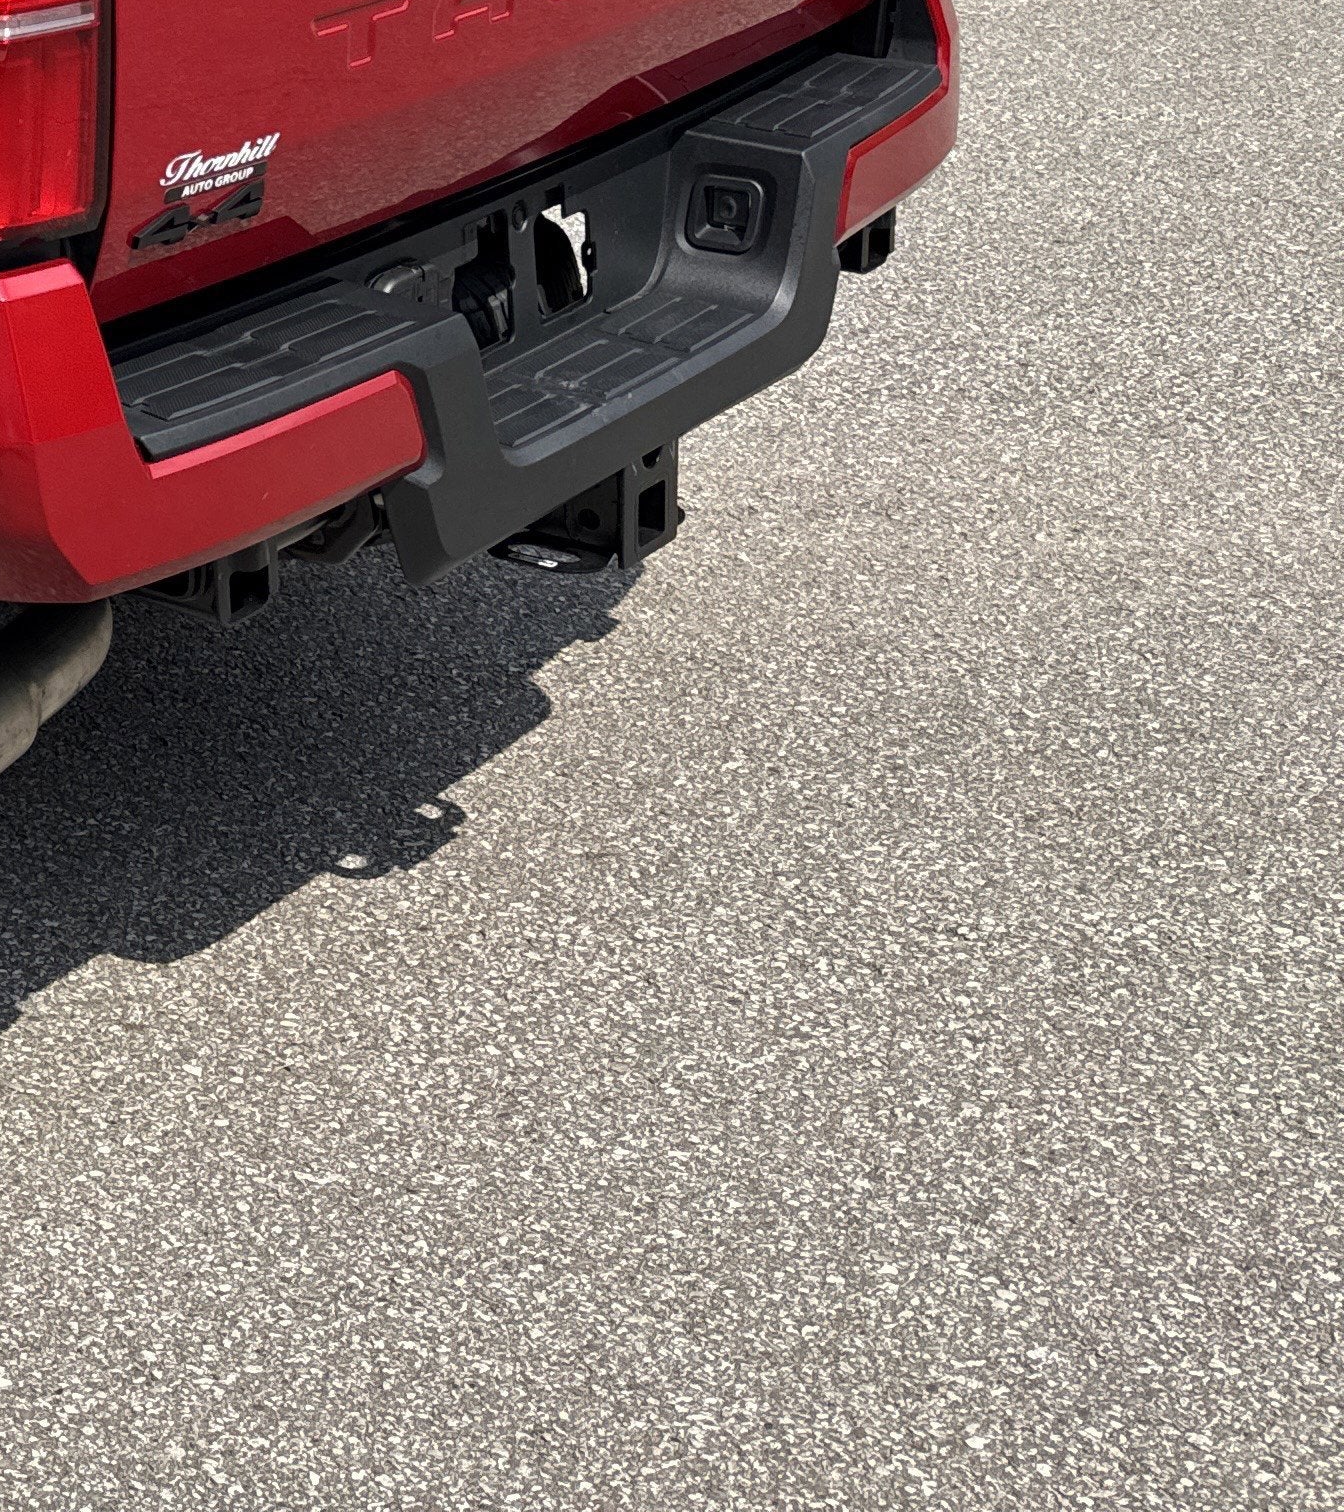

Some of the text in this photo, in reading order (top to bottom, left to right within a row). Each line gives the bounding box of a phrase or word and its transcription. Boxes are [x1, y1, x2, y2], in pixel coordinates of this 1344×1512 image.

[159, 132, 281, 186] Thornhill
[181, 167, 254, 198] AUTO GROUP
